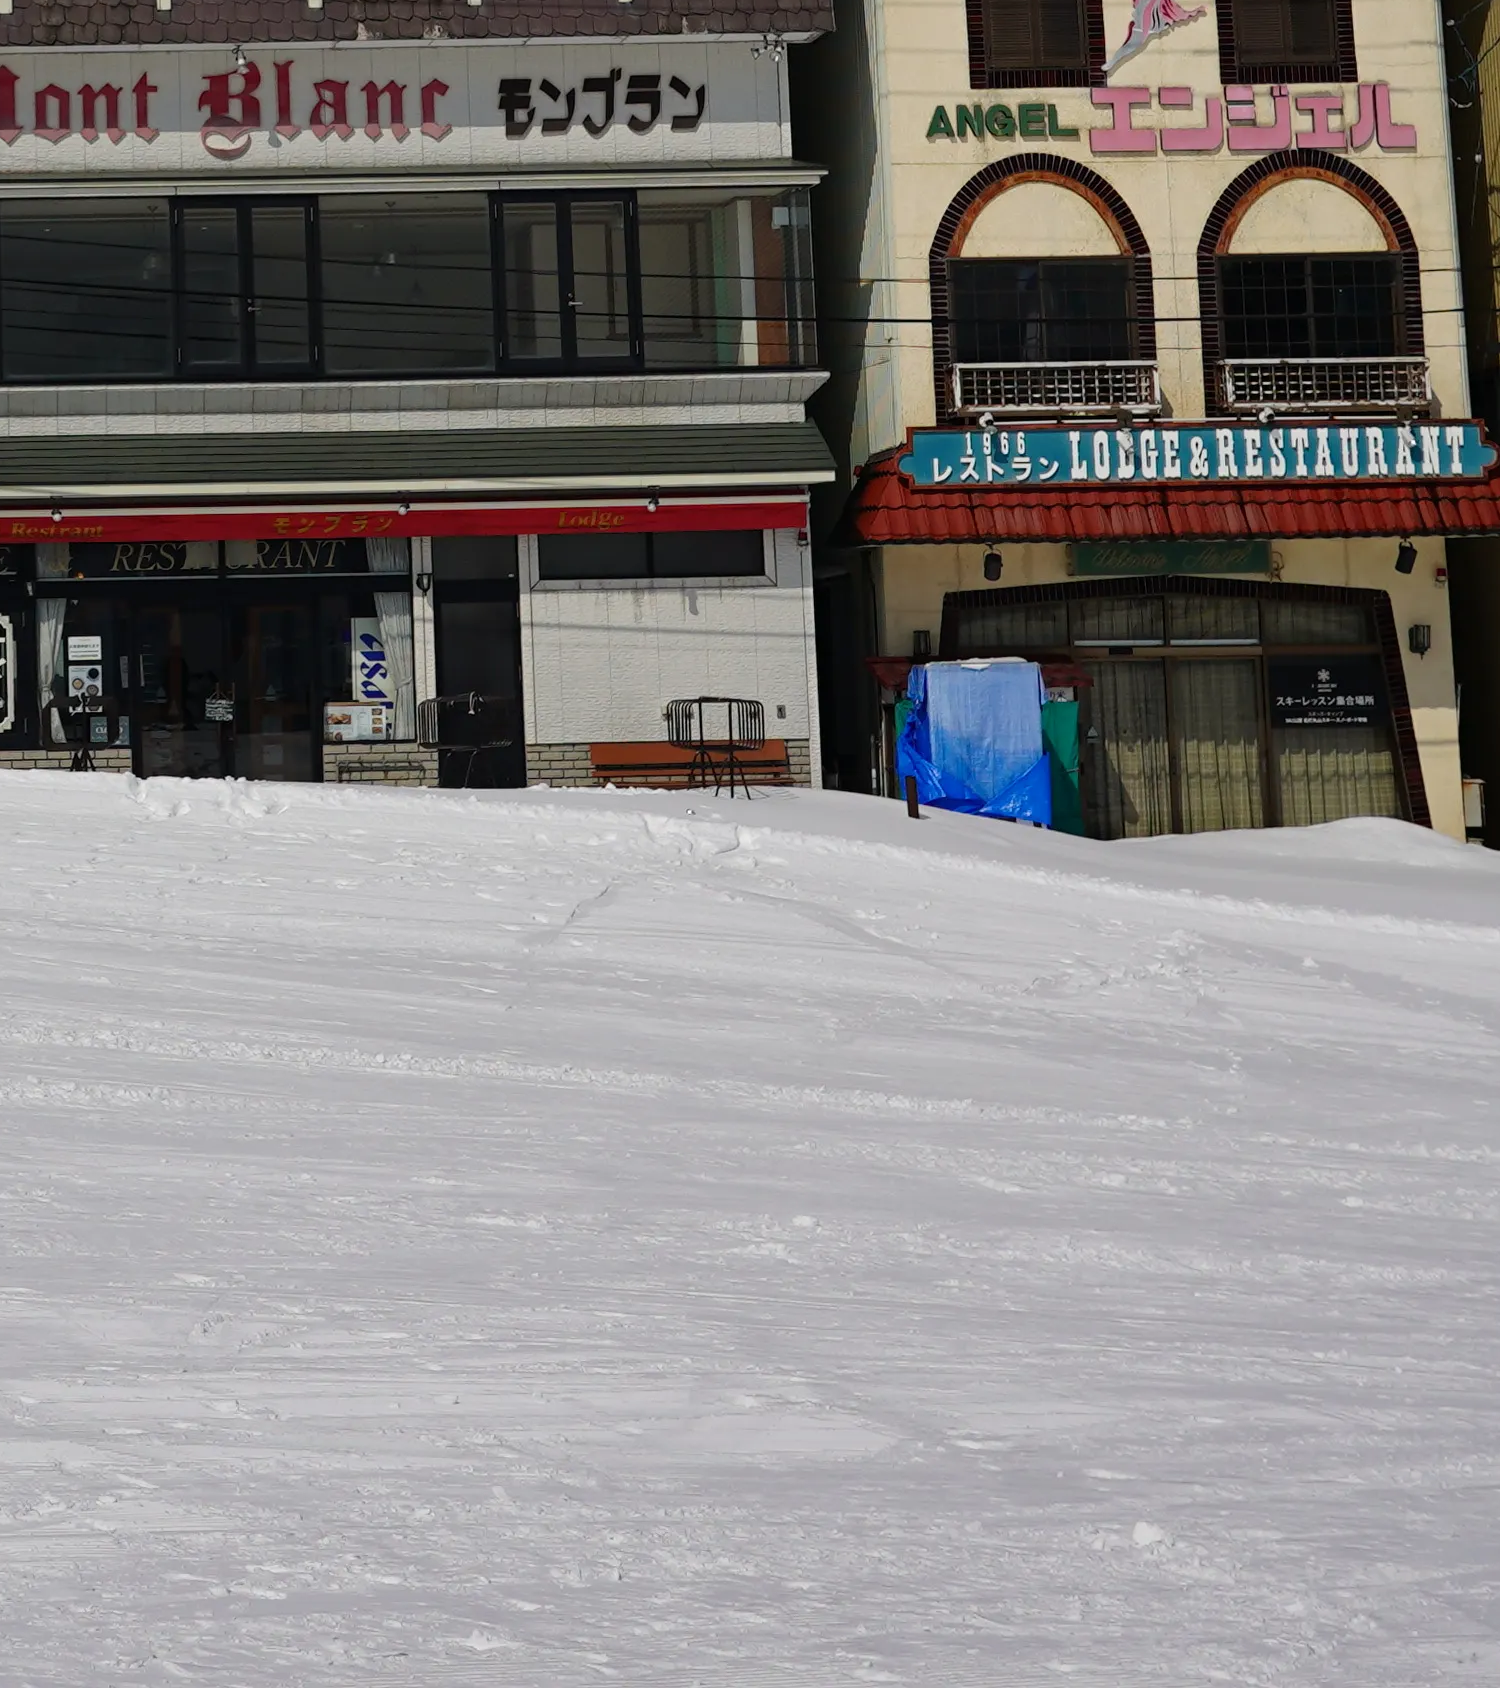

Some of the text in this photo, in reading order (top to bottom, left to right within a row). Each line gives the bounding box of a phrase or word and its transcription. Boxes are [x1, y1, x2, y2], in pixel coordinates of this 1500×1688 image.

[198, 59, 453, 160] Blanc
[497, 69, 707, 139] モンブラン
[926, 101, 1079, 140] ANGEL
[1089, 82, 1418, 154] エンジェル
[964, 430, 1027, 456] 1966
[932, 456, 1059, 484] レストラン
[272, 515, 394, 534] モンブラン
[558, 509, 625, 529] Lodge
[110, 539, 346, 572] RESTRANT
